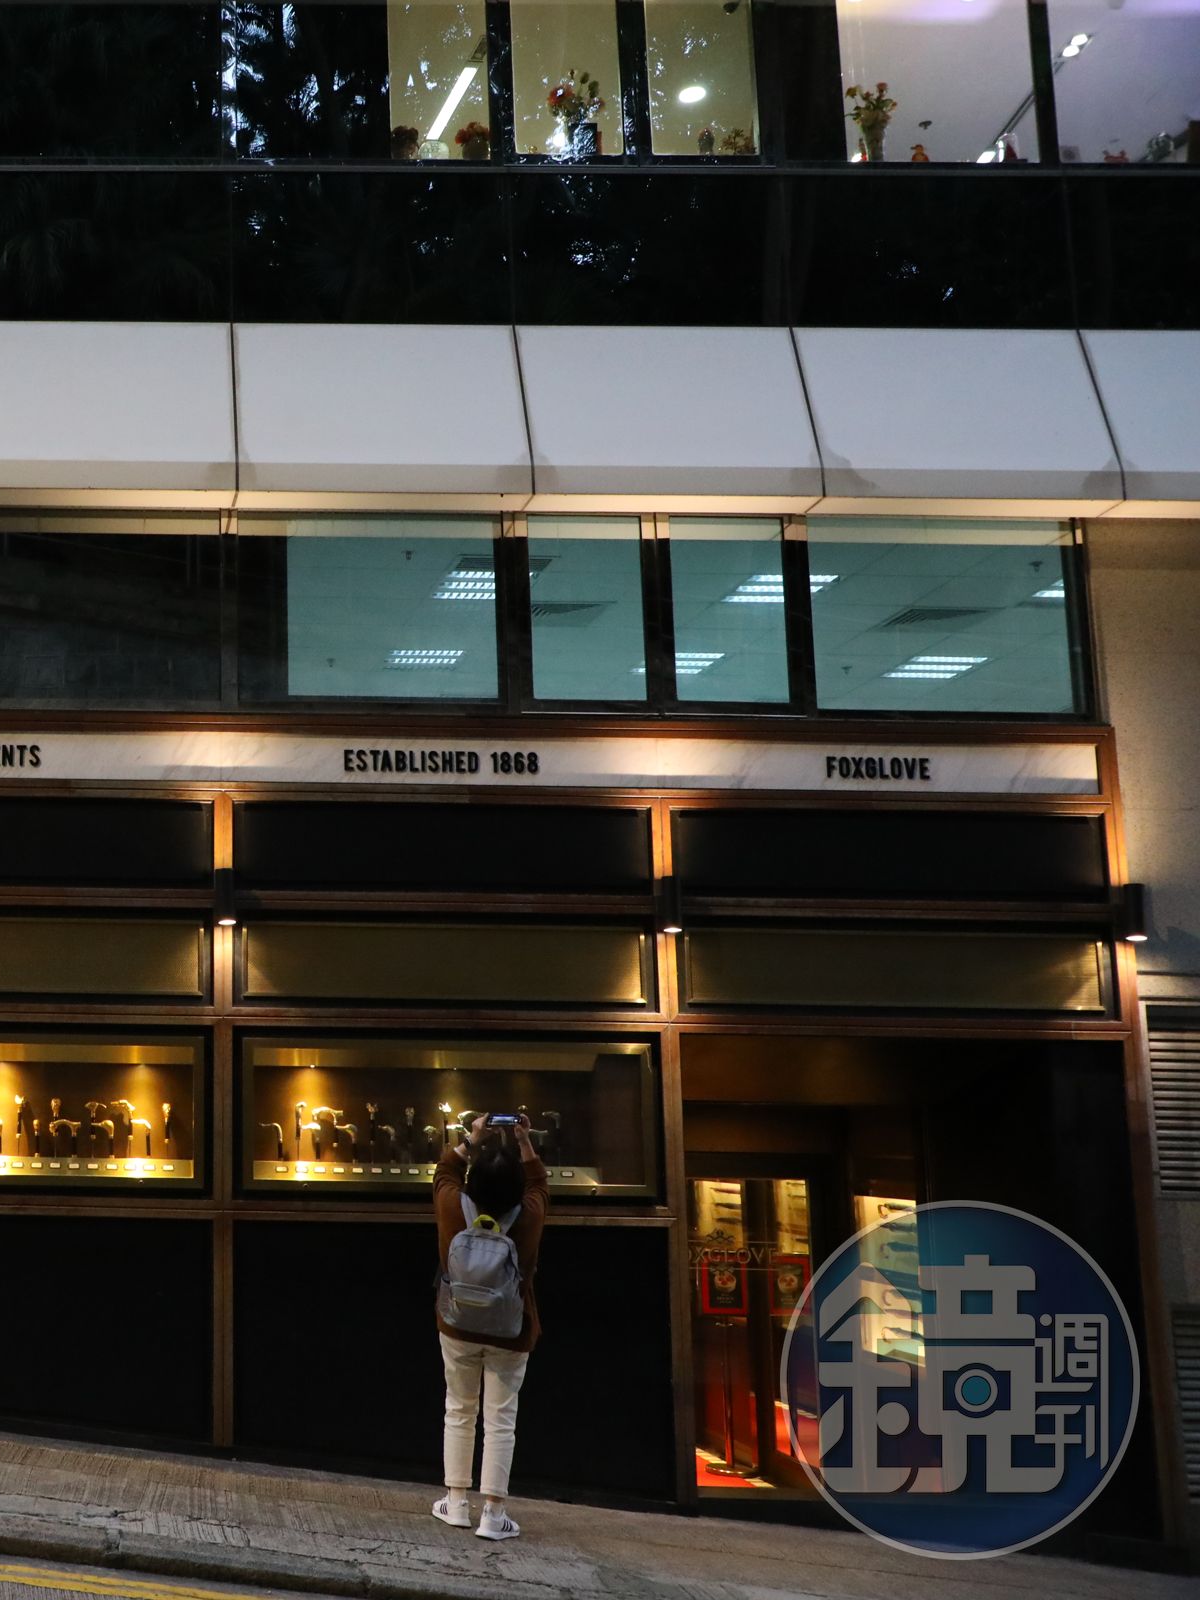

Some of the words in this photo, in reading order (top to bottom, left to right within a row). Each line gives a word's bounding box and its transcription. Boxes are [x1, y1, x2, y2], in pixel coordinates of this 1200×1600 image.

[343, 749, 480, 773] ESTABLISHED
[490, 751, 540, 774] 1868
[825, 756, 931, 780] FOXGLOVE
